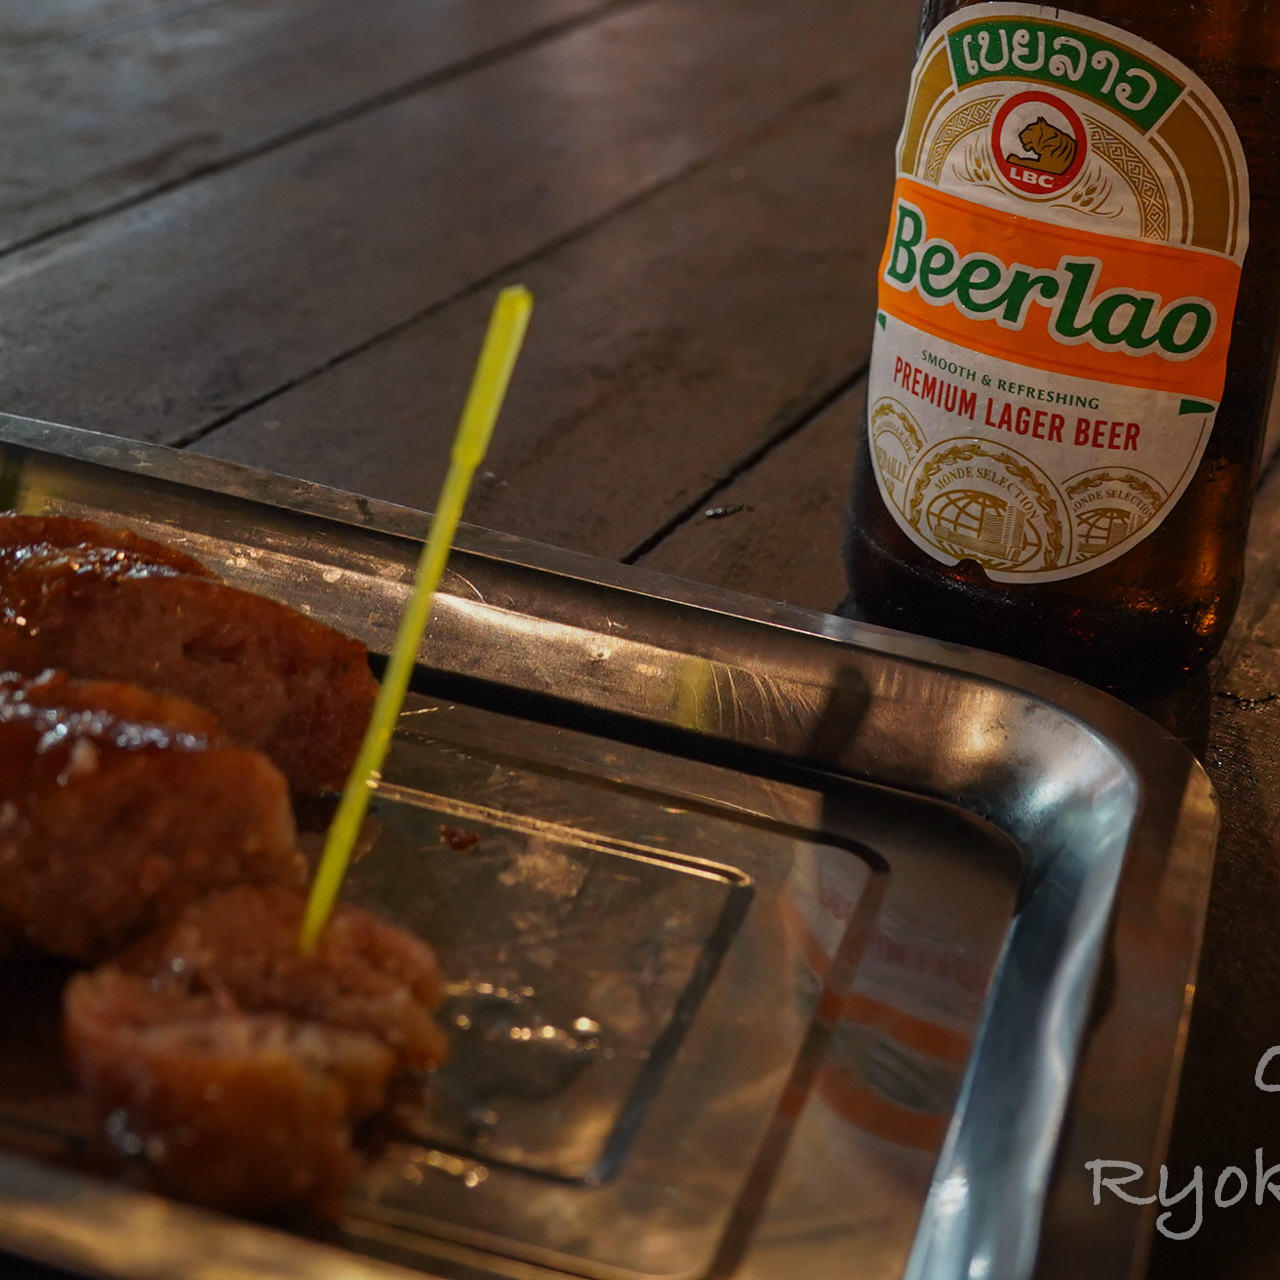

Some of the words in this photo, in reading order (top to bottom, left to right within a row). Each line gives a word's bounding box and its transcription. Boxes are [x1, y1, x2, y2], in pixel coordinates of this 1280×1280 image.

[962, 28, 1158, 111] ເບຍລາວ
[1009, 167, 1054, 188] LBC
[887, 204, 1212, 354] Beerlao
[893, 356, 978, 420] PREMIUM
[984, 397, 1065, 444] LAGER
[1073, 417, 1141, 451] BEER
[921, 349, 977, 382] SMOOTH
[981, 374, 992, 387] &
[997, 379, 1101, 410] REFRESHING
[933, 466, 974, 493] MONDE
[976, 466, 1039, 521] SELECTION
